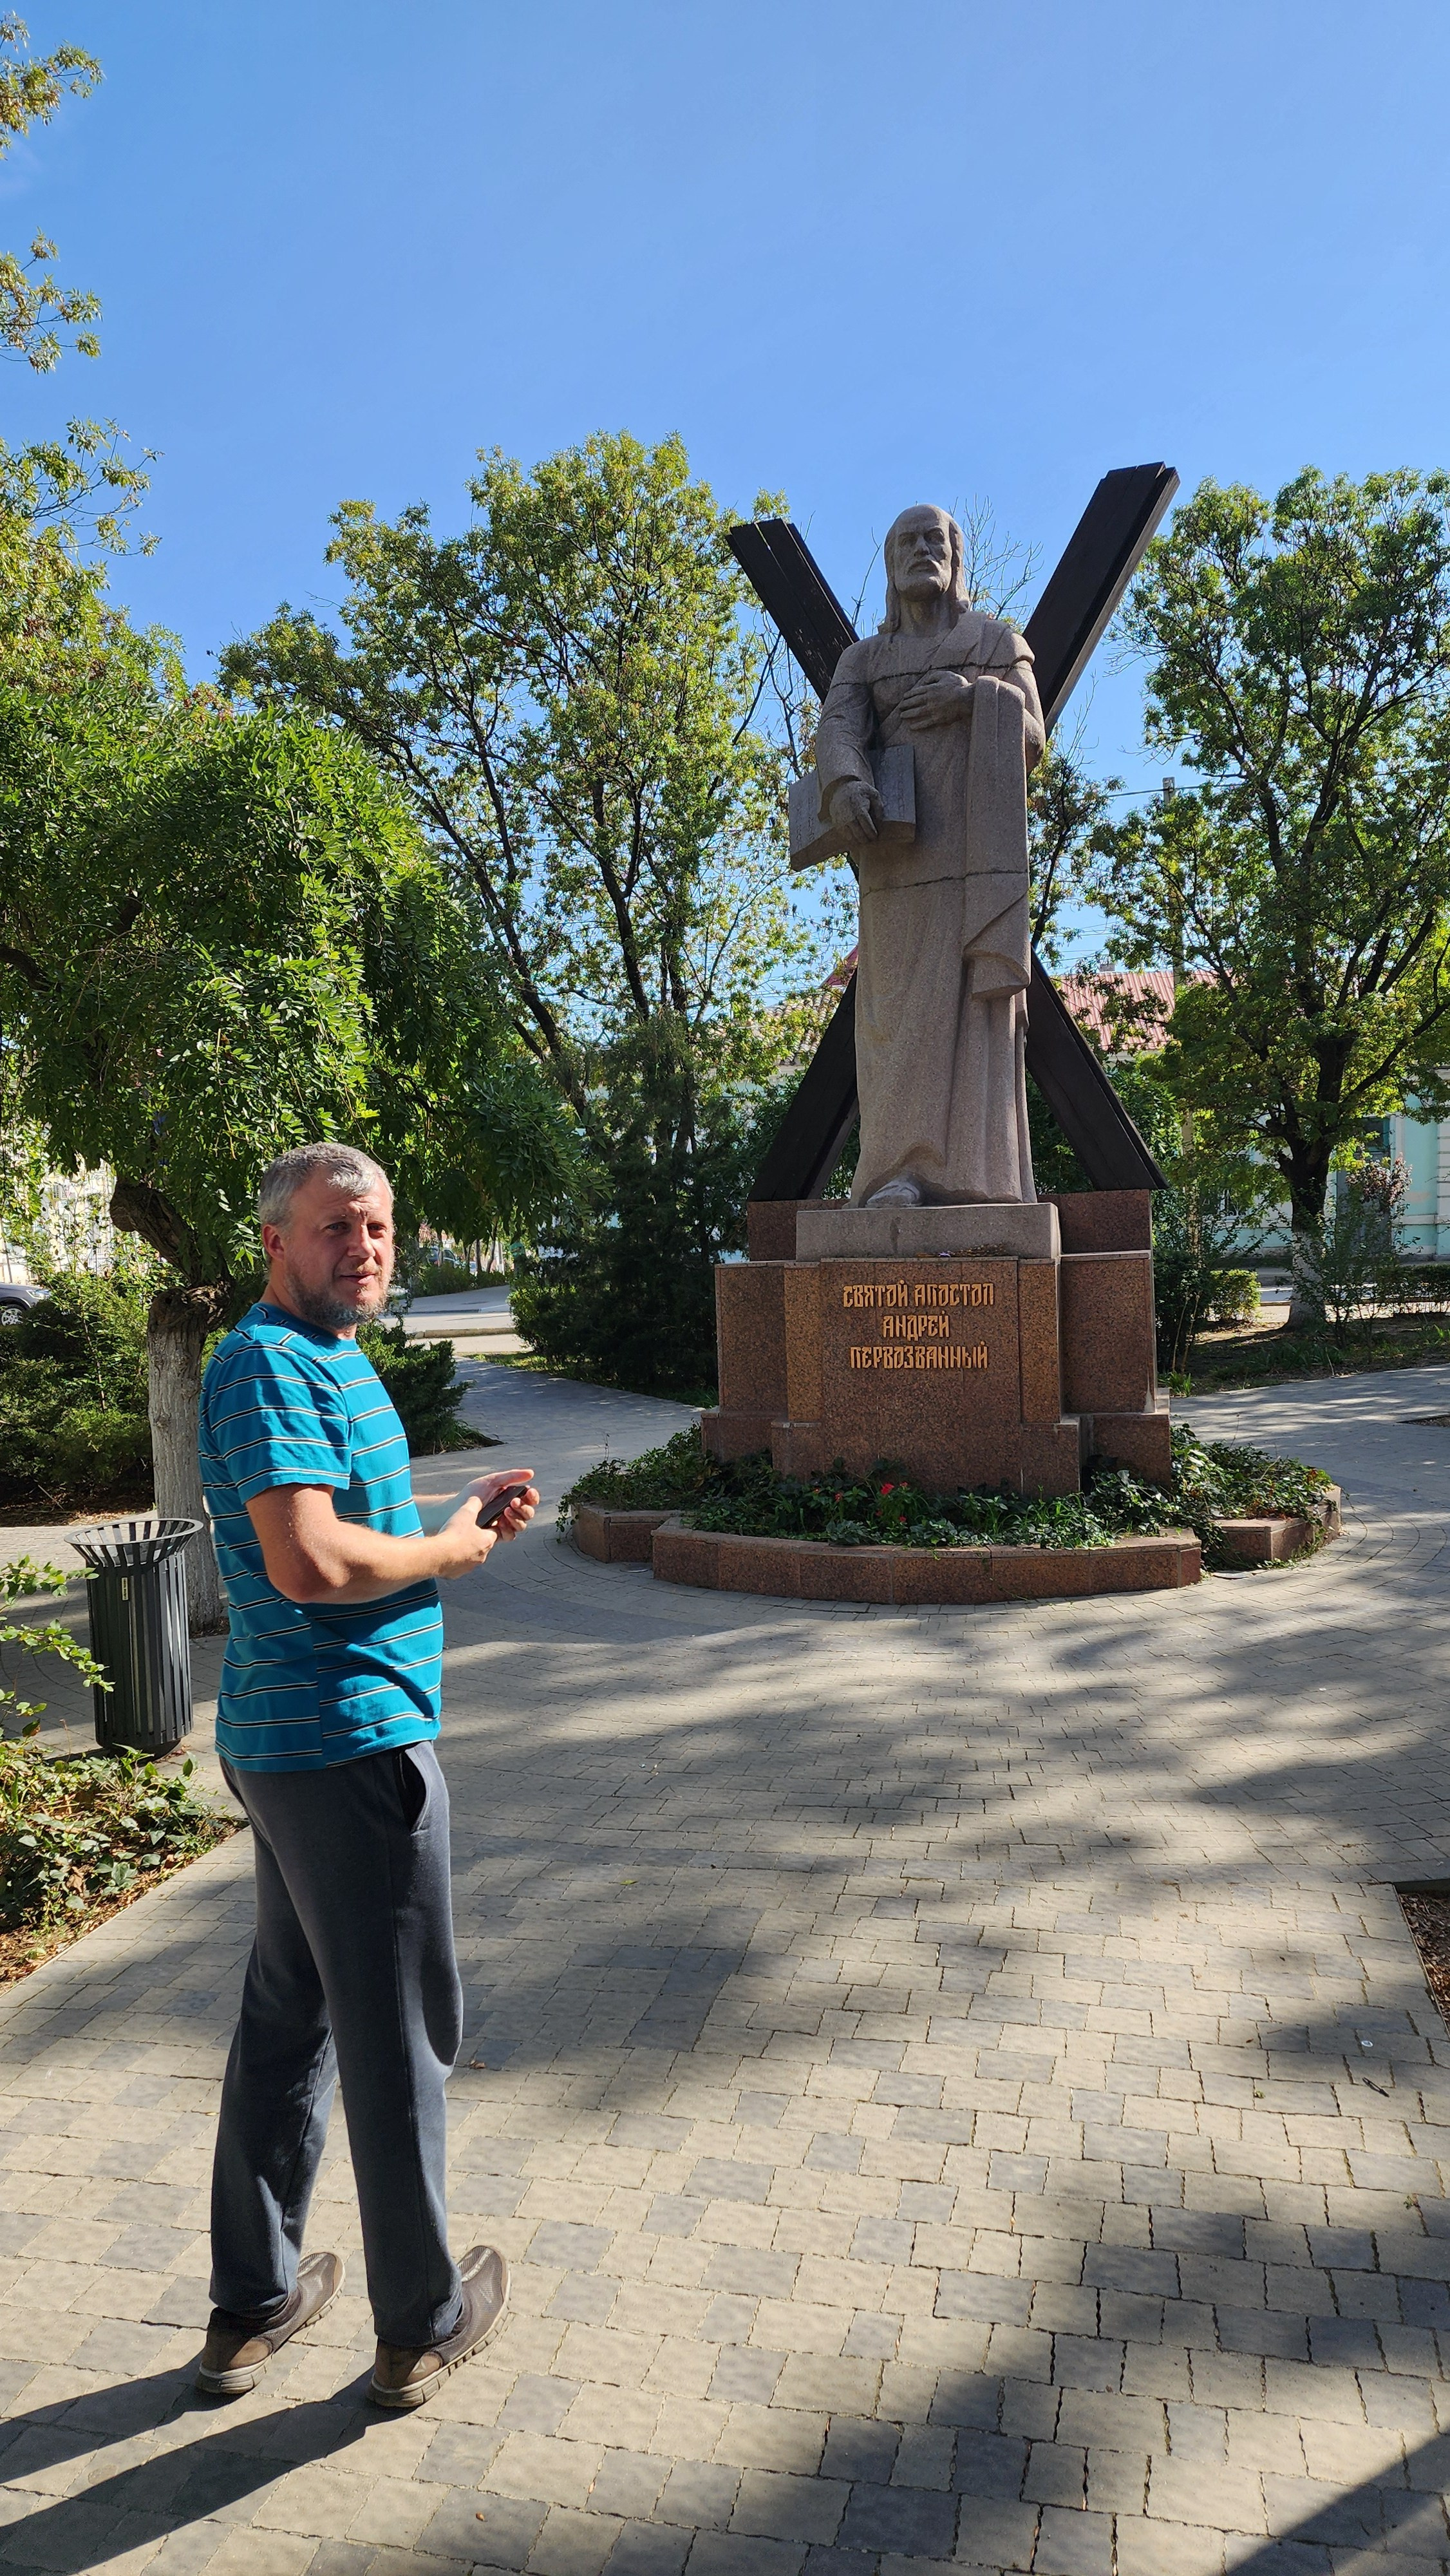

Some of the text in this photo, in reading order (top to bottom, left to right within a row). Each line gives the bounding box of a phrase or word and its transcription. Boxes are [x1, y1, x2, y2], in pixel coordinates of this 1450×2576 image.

[843, 1280, 994, 1307] СВЯТОЙ АПОСТОЛ
[883, 1311, 950, 1341] АНДРЕЙ
[850, 1341, 989, 1369] ПЕРВОЗВАННЫЙ
